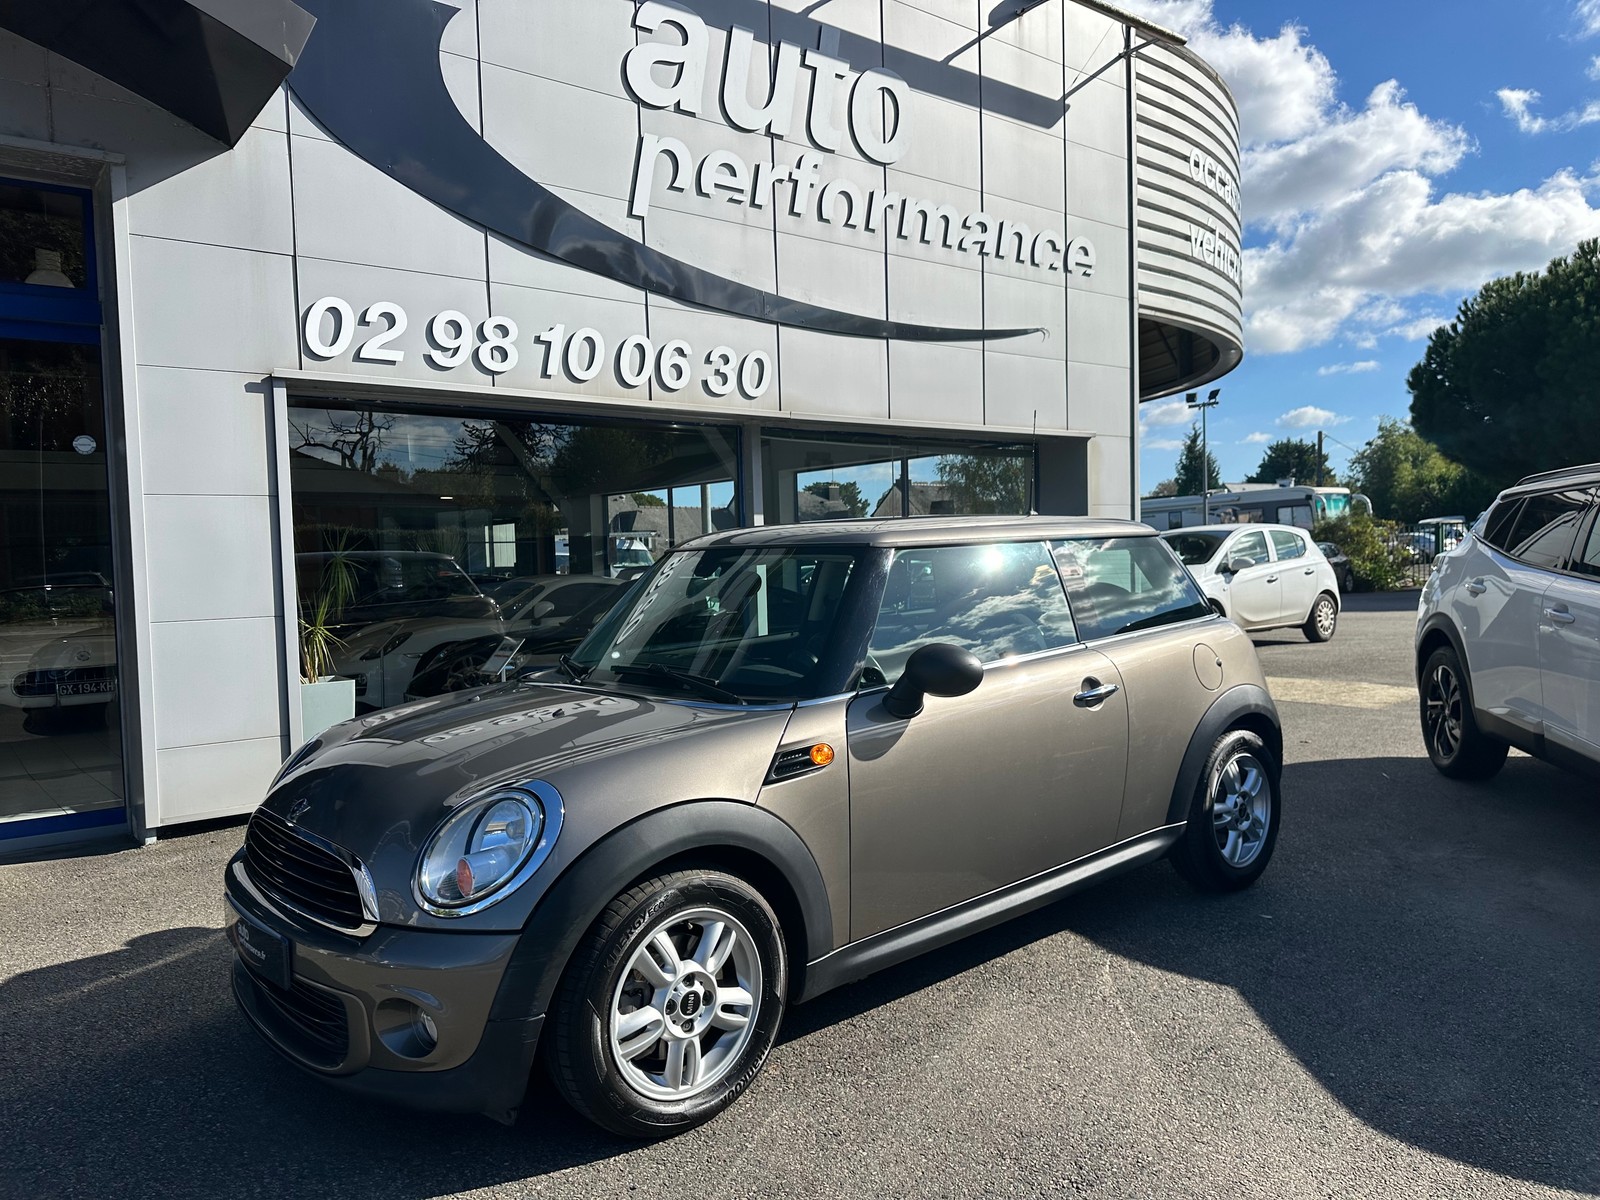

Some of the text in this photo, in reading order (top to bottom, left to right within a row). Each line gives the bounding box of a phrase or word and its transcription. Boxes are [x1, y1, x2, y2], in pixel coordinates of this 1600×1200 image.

[621, 0, 912, 165] auto
[628, 132, 1097, 276] performance
[303, 296, 772, 399] 02 98 10 06 30
[59, 682, 114, 695] GX-194-KH
[686, 993, 695, 1014] MINI
